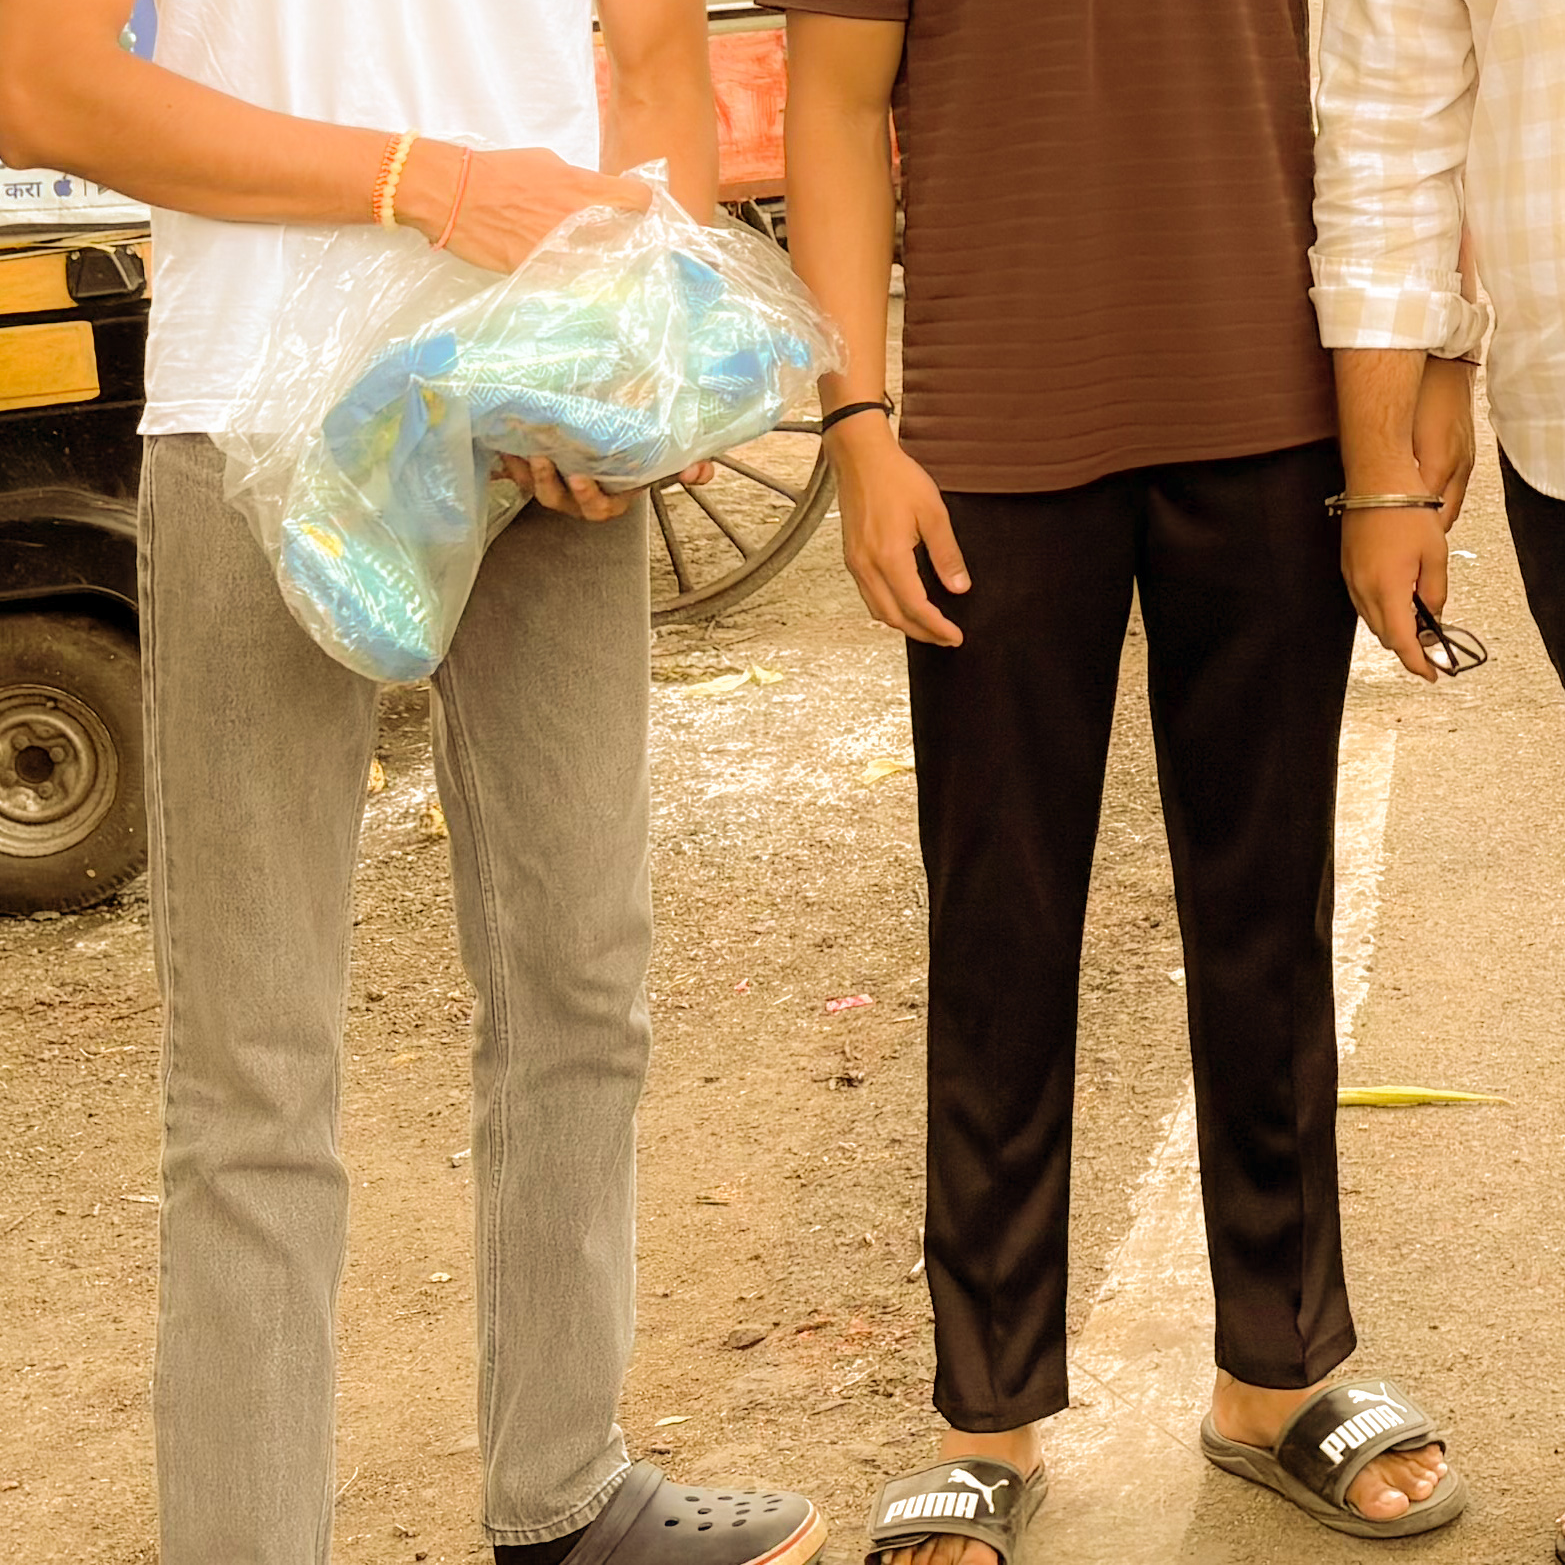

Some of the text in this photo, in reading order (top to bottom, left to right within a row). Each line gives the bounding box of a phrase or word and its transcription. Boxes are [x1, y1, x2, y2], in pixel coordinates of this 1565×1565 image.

[4, 181, 42, 199] करा
[1319, 1404, 1405, 1465] PUMA
[883, 1492, 979, 1524] PUMA
